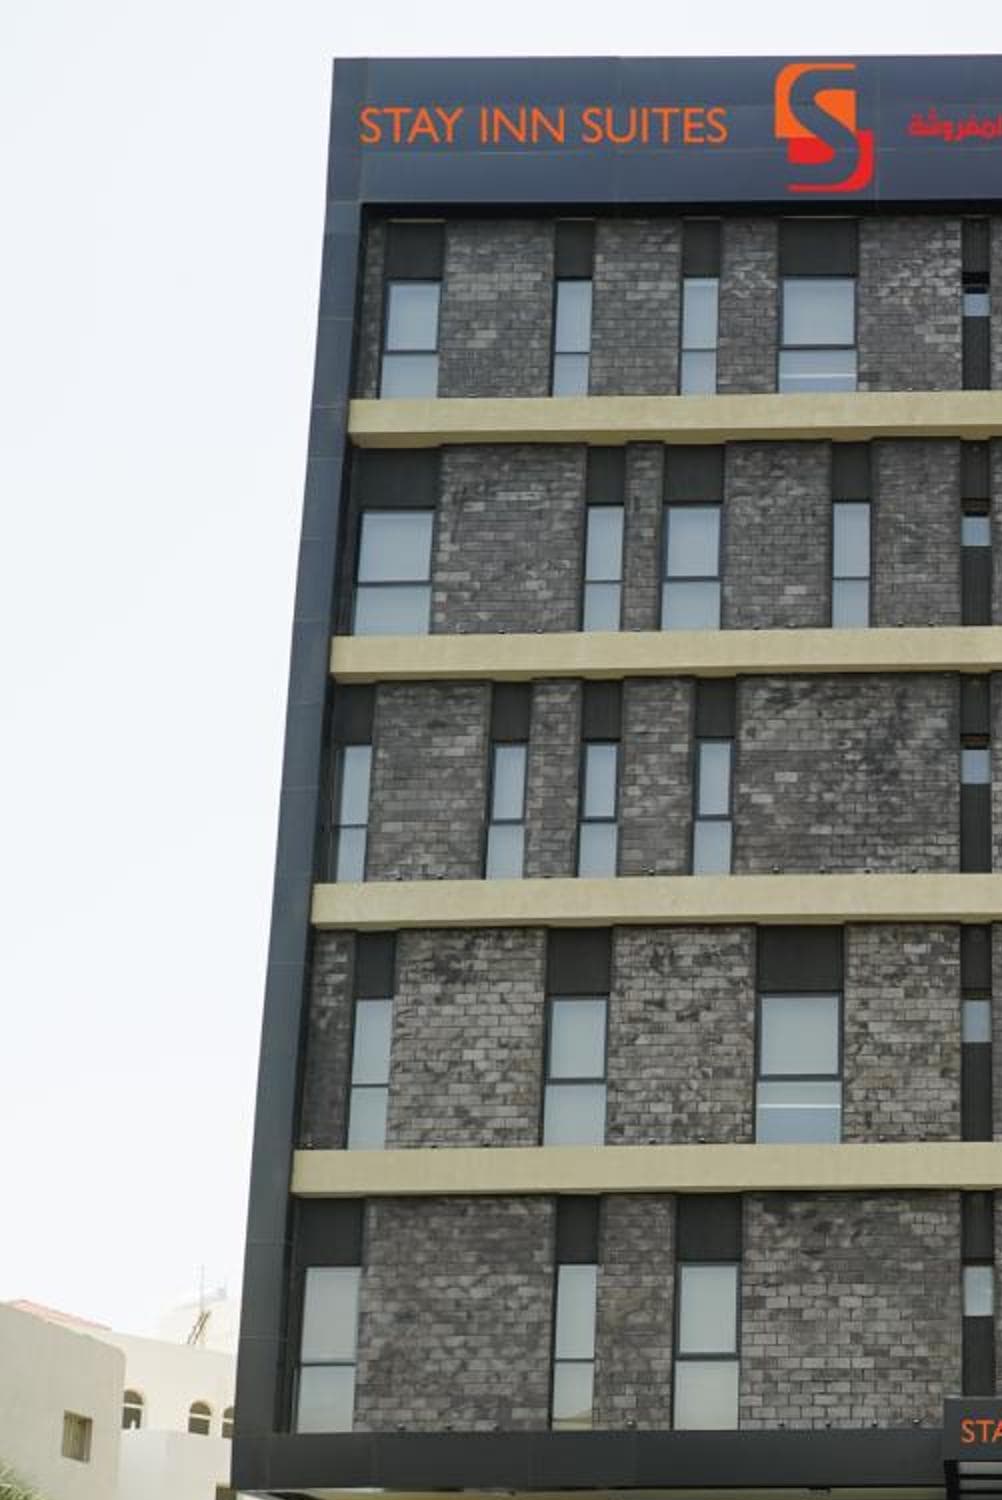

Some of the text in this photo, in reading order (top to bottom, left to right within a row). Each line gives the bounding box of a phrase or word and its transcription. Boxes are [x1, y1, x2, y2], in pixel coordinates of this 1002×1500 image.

[359, 106, 729, 144] STAY INN SUITES
